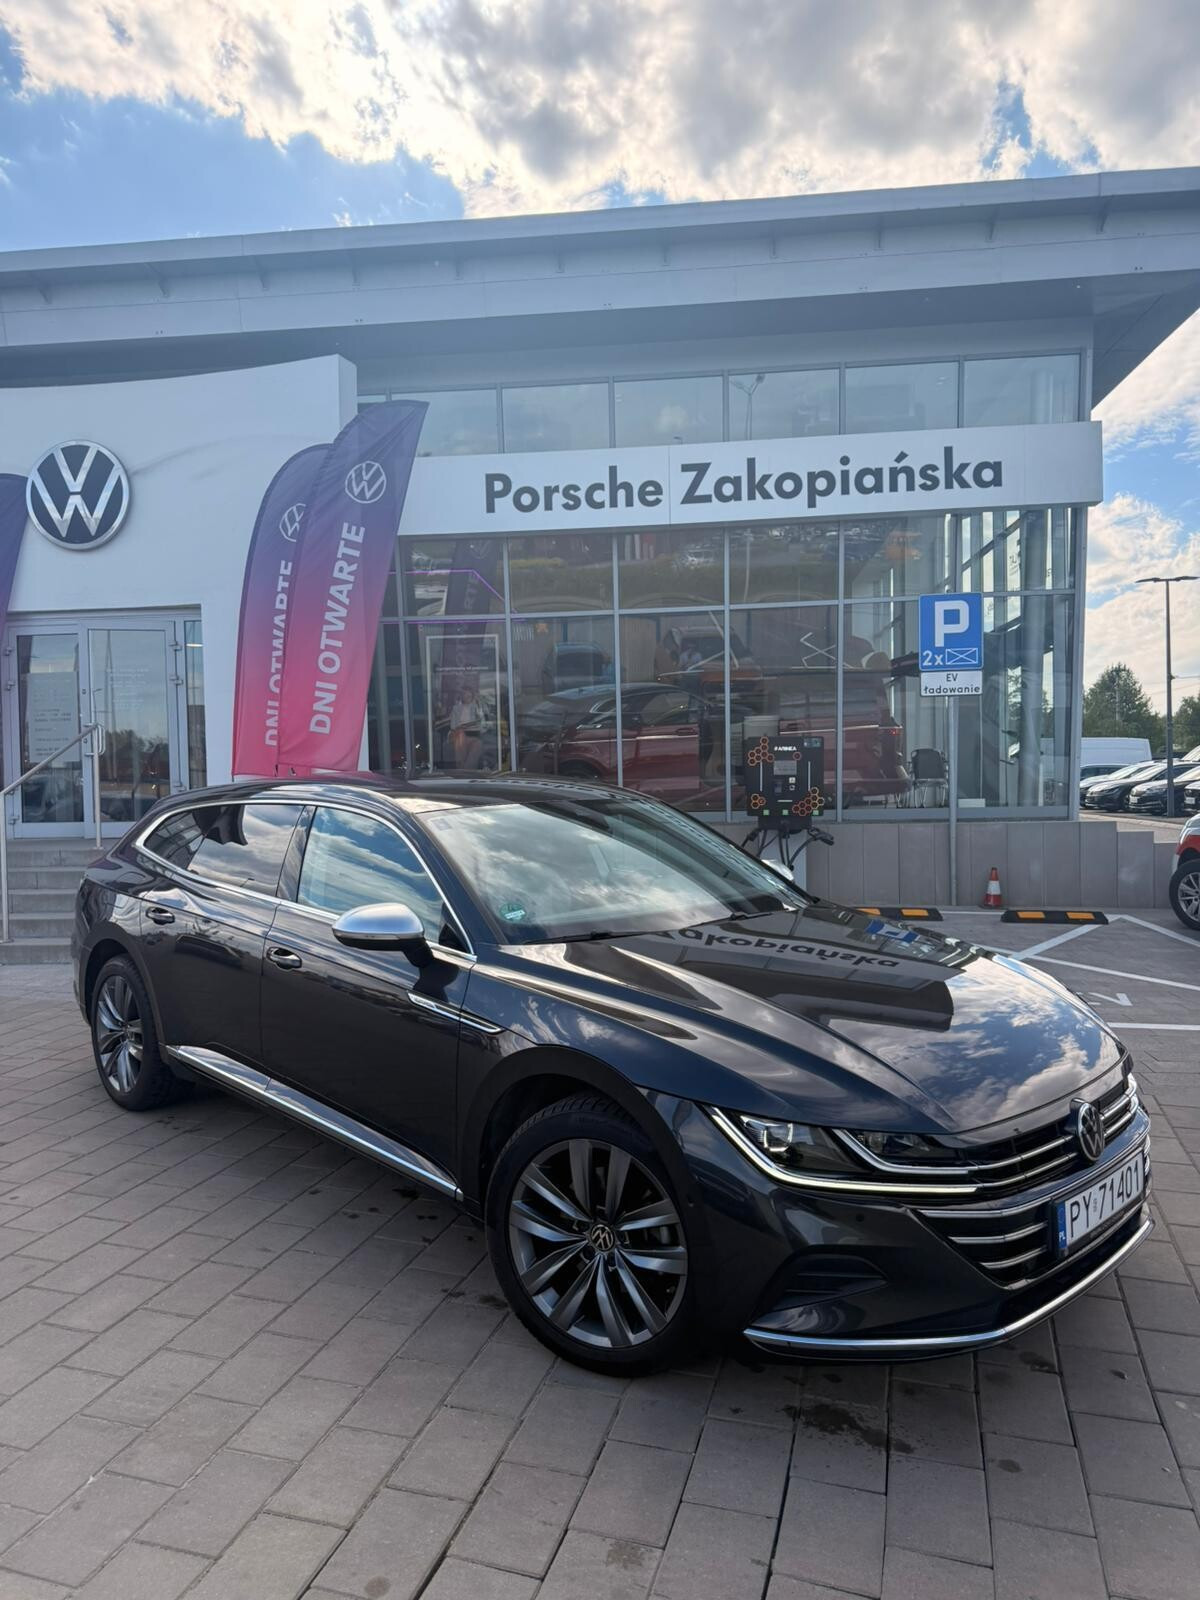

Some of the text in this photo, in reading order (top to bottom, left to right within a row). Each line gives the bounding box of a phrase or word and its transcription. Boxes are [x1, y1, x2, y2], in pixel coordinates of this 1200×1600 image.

[485, 446, 1003, 514] Porsche Zakopiańska
[309, 522, 366, 735] DNI OTWARTE
[935, 600, 970, 648] P
[922, 650, 944, 666] 2x
[946, 673, 959, 682] EV
[923, 684, 980, 694] ładowanie
[1070, 1191, 1092, 1238] PY
[1099, 1160, 1139, 1220] 71401
